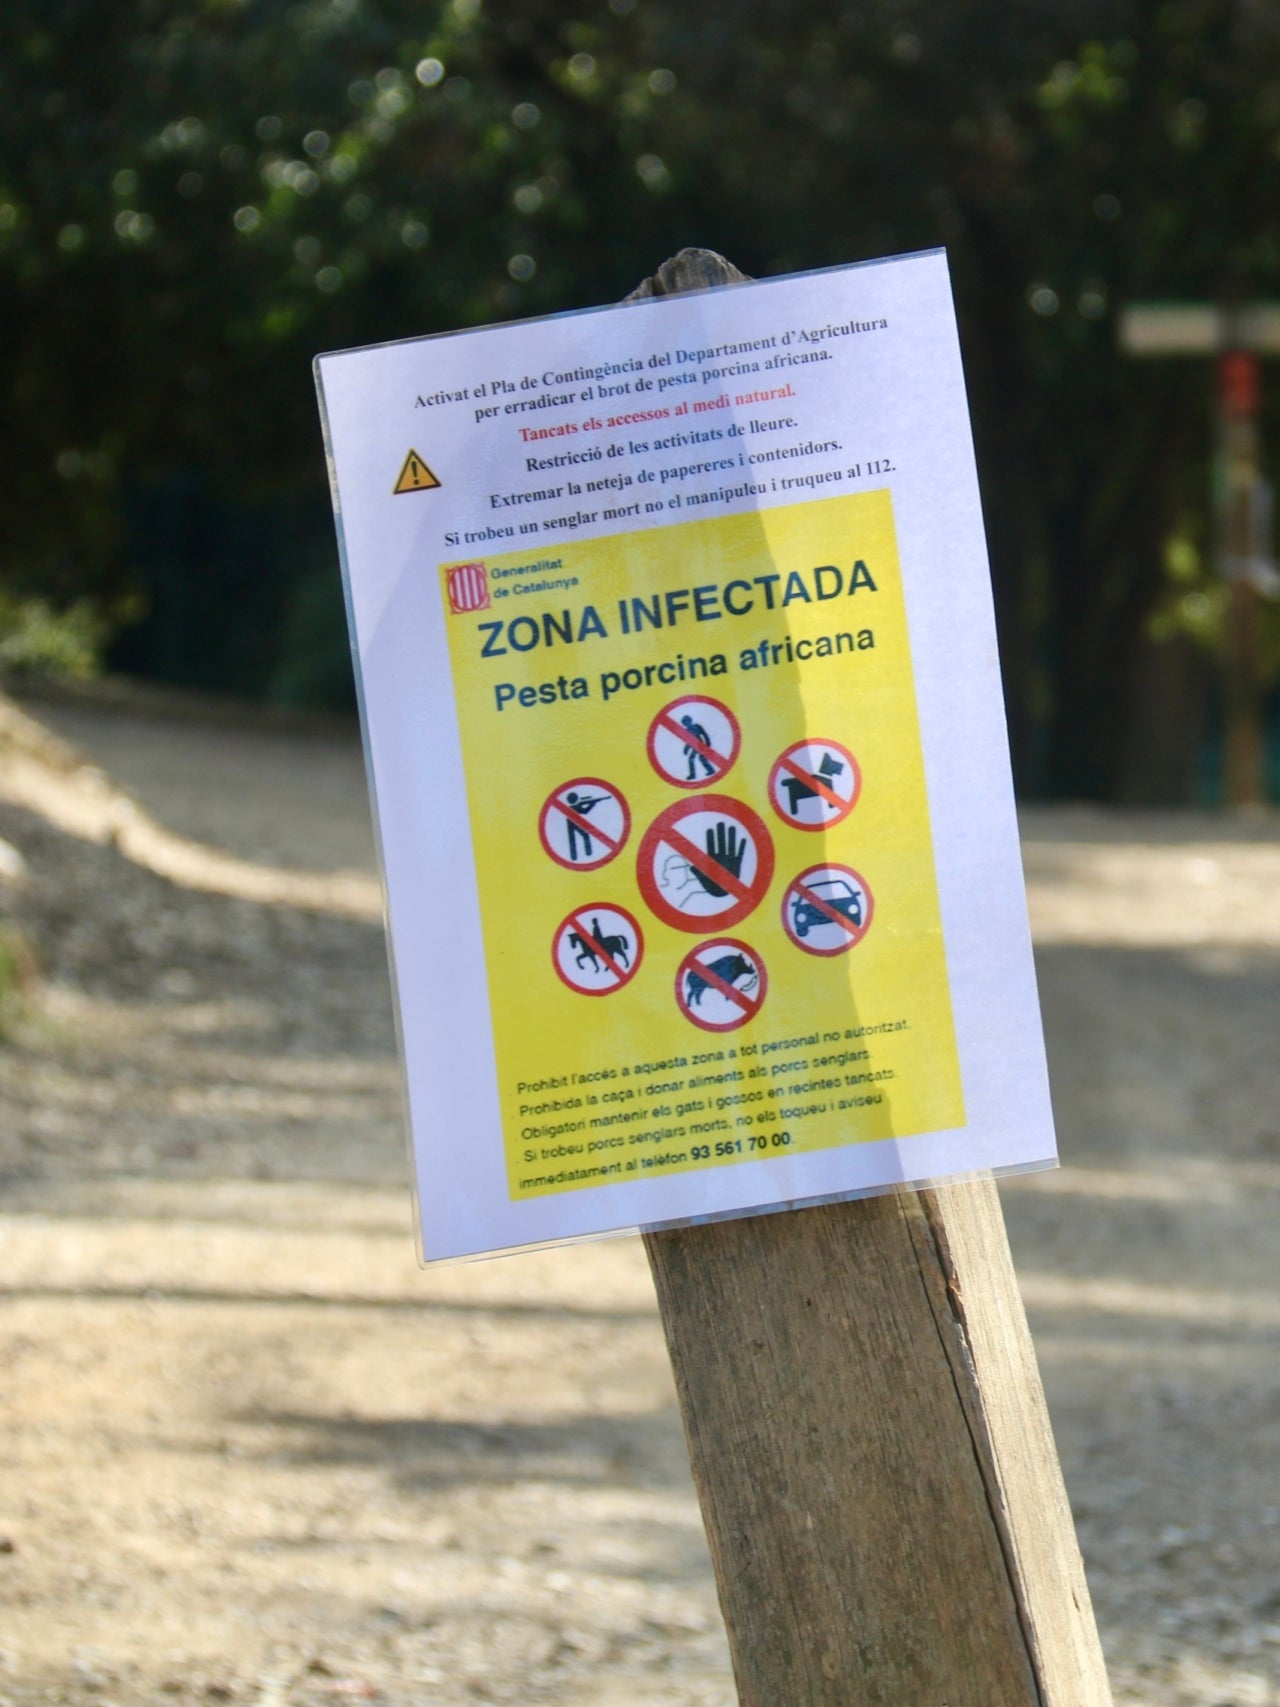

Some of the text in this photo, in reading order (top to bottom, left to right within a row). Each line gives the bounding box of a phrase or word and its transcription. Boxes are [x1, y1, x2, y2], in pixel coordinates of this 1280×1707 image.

[414, 388, 470, 409] Activat
[473, 383, 488, 399] el
[490, 379, 517, 396] Pla
[519, 375, 538, 391] de
[541, 357, 644, 387] Contingència
[647, 351, 672, 369] del
[675, 335, 777, 365] Departament
[474, 350, 833, 424] per erradicar el brot de pesta porcina africana.
[518, 383, 796, 443] Tancats els accessos al medi natural.
[525, 417, 799, 473] Restricció de les activitats de lleure.
[444, 458, 897, 547] Si trobeu un senglar mort no el manipuleu i truqueu al 112.
[489, 440, 843, 509] Extremar la neteja de papereres i contenidors.
[490, 558, 564, 580] Generalitat
[492, 576, 579, 599] de Catalunya
[477, 559, 879, 658] ZONA INFECTADA
[493, 628, 876, 712] Pesta porcina africana
[516, 1075, 569, 1095] Prohibit
[620, 1066, 632, 1078] a
[632, 1056, 689, 1076] aquesta
[691, 1050, 726, 1066] zona
[727, 1048, 739, 1060] a
[739, 1043, 759, 1057] tot
[760, 1031, 820, 1057] personal
[822, 1031, 842, 1043] no
[518, 1096, 584, 1118] Prohibida
[585, 1093, 599, 1106] la
[601, 1088, 635, 1104] caça
[636, 1087, 643, 1097] i
[644, 1080, 685, 1097] donar
[687, 1069, 746, 1090] aliments
[747, 1064, 769, 1080] als
[770, 1059, 810, 1078] porcs
[520, 1118, 587, 1141] Obligatori
[588, 1107, 649, 1129] mantenir
[650, 1104, 673, 1119] els
[674, 1100, 706, 1118] gats
[707, 1096, 714, 1110] i
[715, 1090, 765, 1111] gossos
[766, 1086, 785, 1100] en
[787, 1076, 843, 1096] recintes
[523, 1149, 538, 1163] Si
[540, 1143, 585, 1161] trobeu
[586, 1136, 626, 1155] porcs
[627, 1126, 687, 1146] senglars
[735, 1114, 755, 1127] no
[755, 1109, 778, 1124] els
[778, 1103, 828, 1120] toqueu
[829, 1098, 835, 1112] i
[837, 1093, 883, 1111] aviseu
[518, 1161, 623, 1190] immediatament
[624, 1157, 639, 1172] al
[640, 1152, 689, 1169] telèfon
[689, 1144, 712, 1162] 93
[714, 1138, 743, 1157] 561
[746, 1134, 769, 1152] 70
